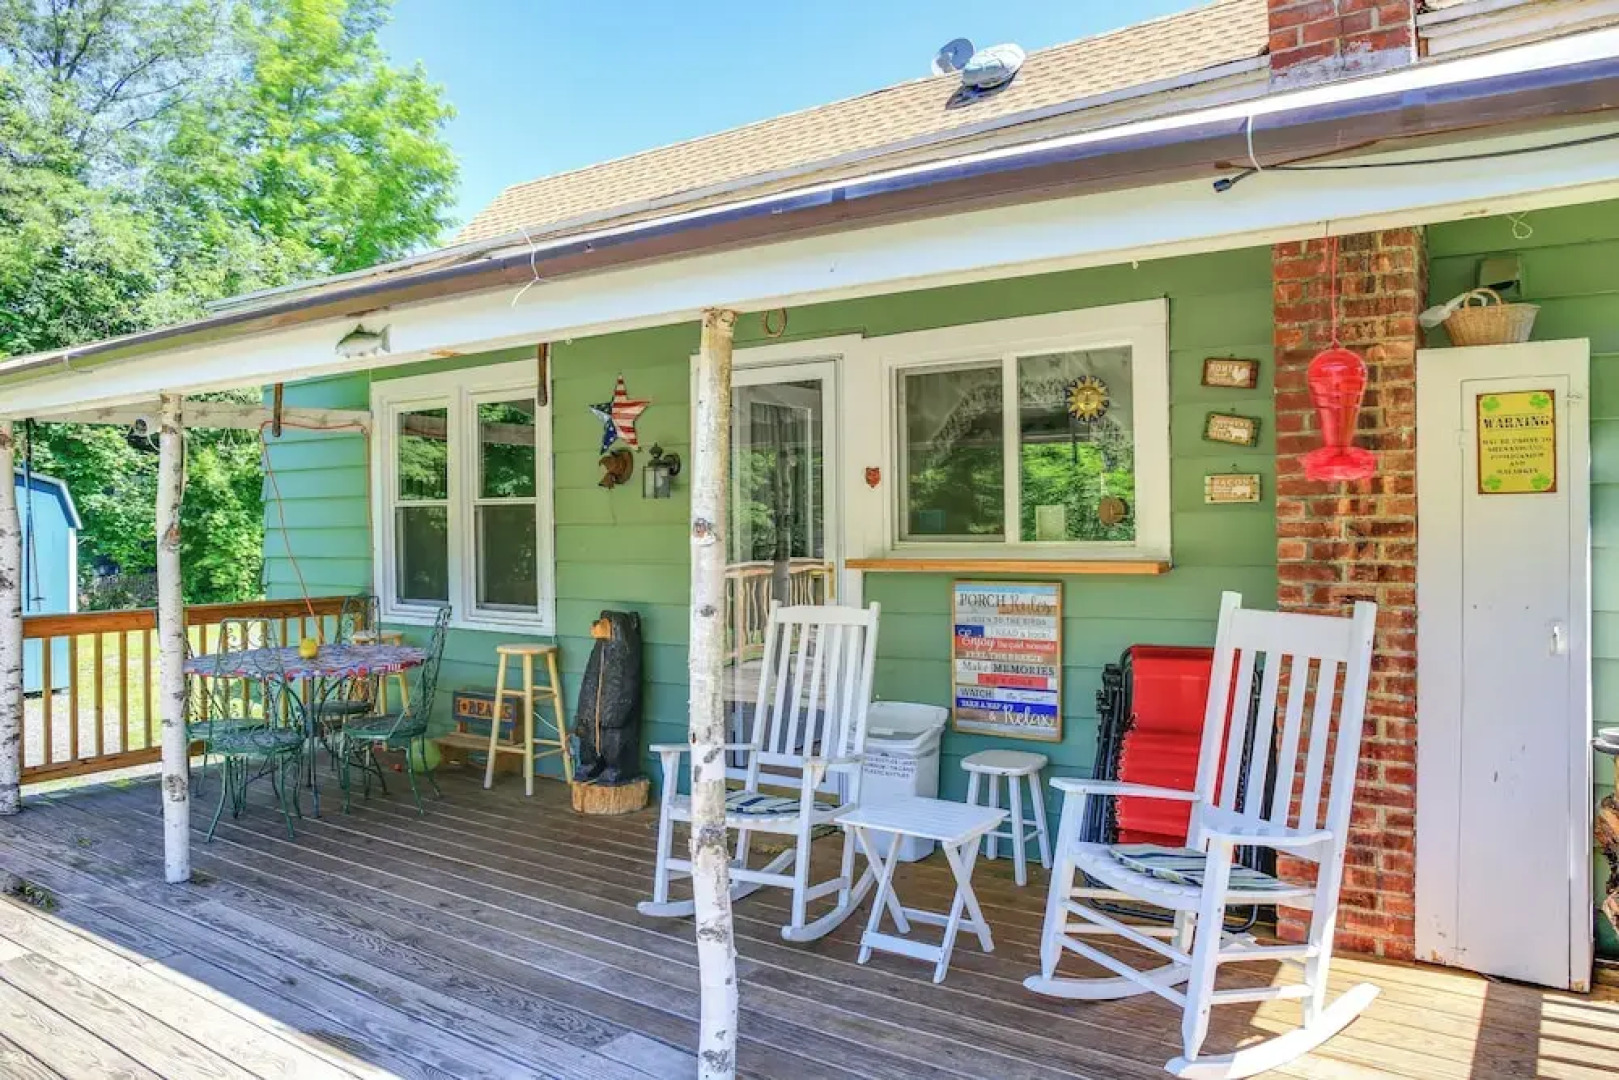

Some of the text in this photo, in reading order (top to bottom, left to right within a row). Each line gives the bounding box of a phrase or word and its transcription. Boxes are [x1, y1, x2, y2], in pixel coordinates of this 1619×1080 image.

[1483, 416, 1550, 428] WARNING
[959, 593, 1054, 613] PORCH Rules
[1006, 617, 1019, 625] THE
[958, 629, 994, 650] Enjoy
[961, 660, 1055, 675] Make MEMORIES
[959, 688, 992, 697] WATCH
[468, 700, 513, 720] BEAS
